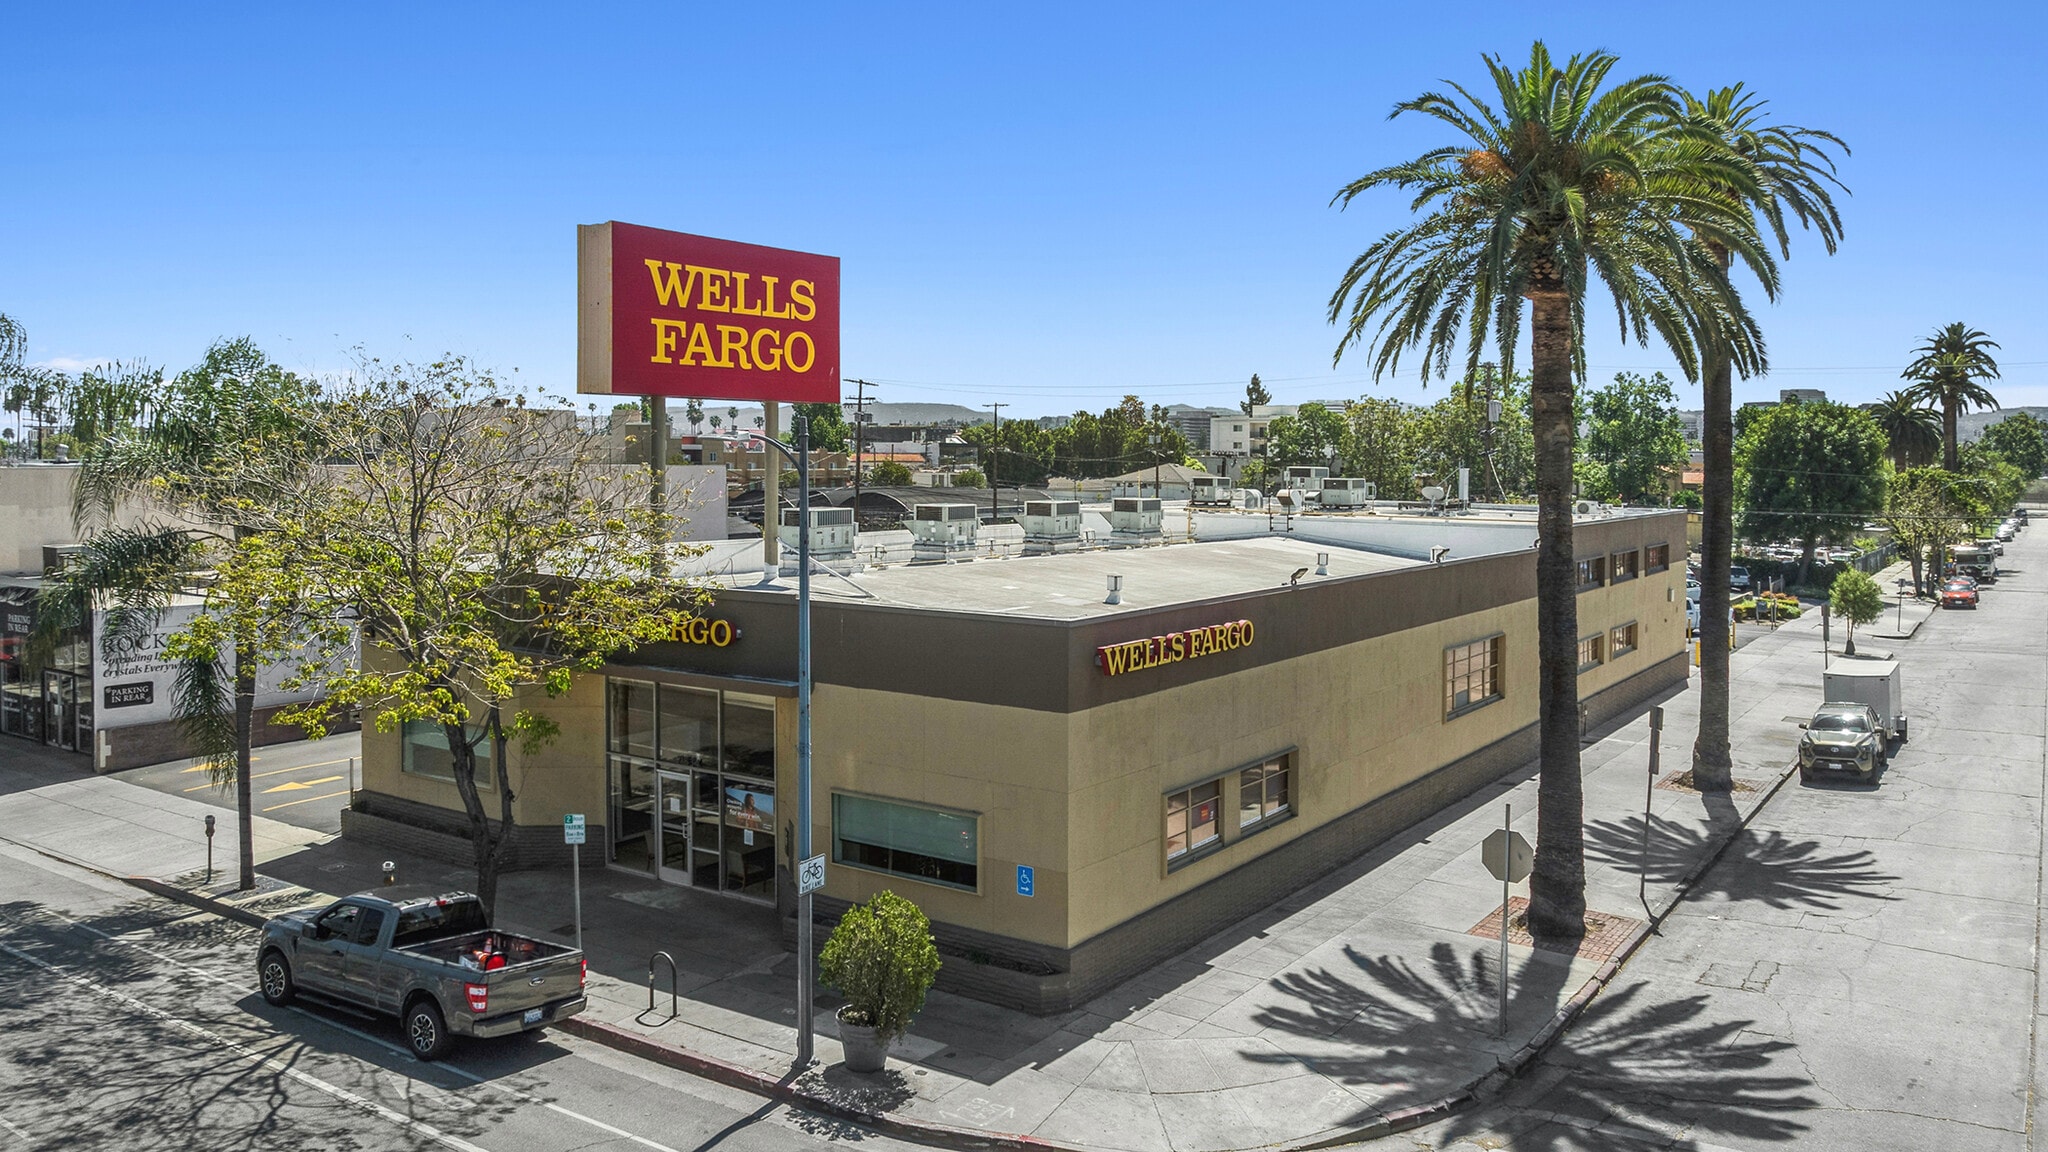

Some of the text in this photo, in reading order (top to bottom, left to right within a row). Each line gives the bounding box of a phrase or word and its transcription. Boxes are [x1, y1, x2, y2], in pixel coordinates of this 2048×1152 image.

[644, 258, 816, 322] WELLS
[650, 317, 816, 373] FARGO
[7, 614, 31, 625] PARKING
[7, 623, 29, 633] IN REAR
[1103, 619, 1255, 676] WELLS FARGO
[111, 685, 149, 696] PARKING
[111, 693, 146, 703] IN REAR
